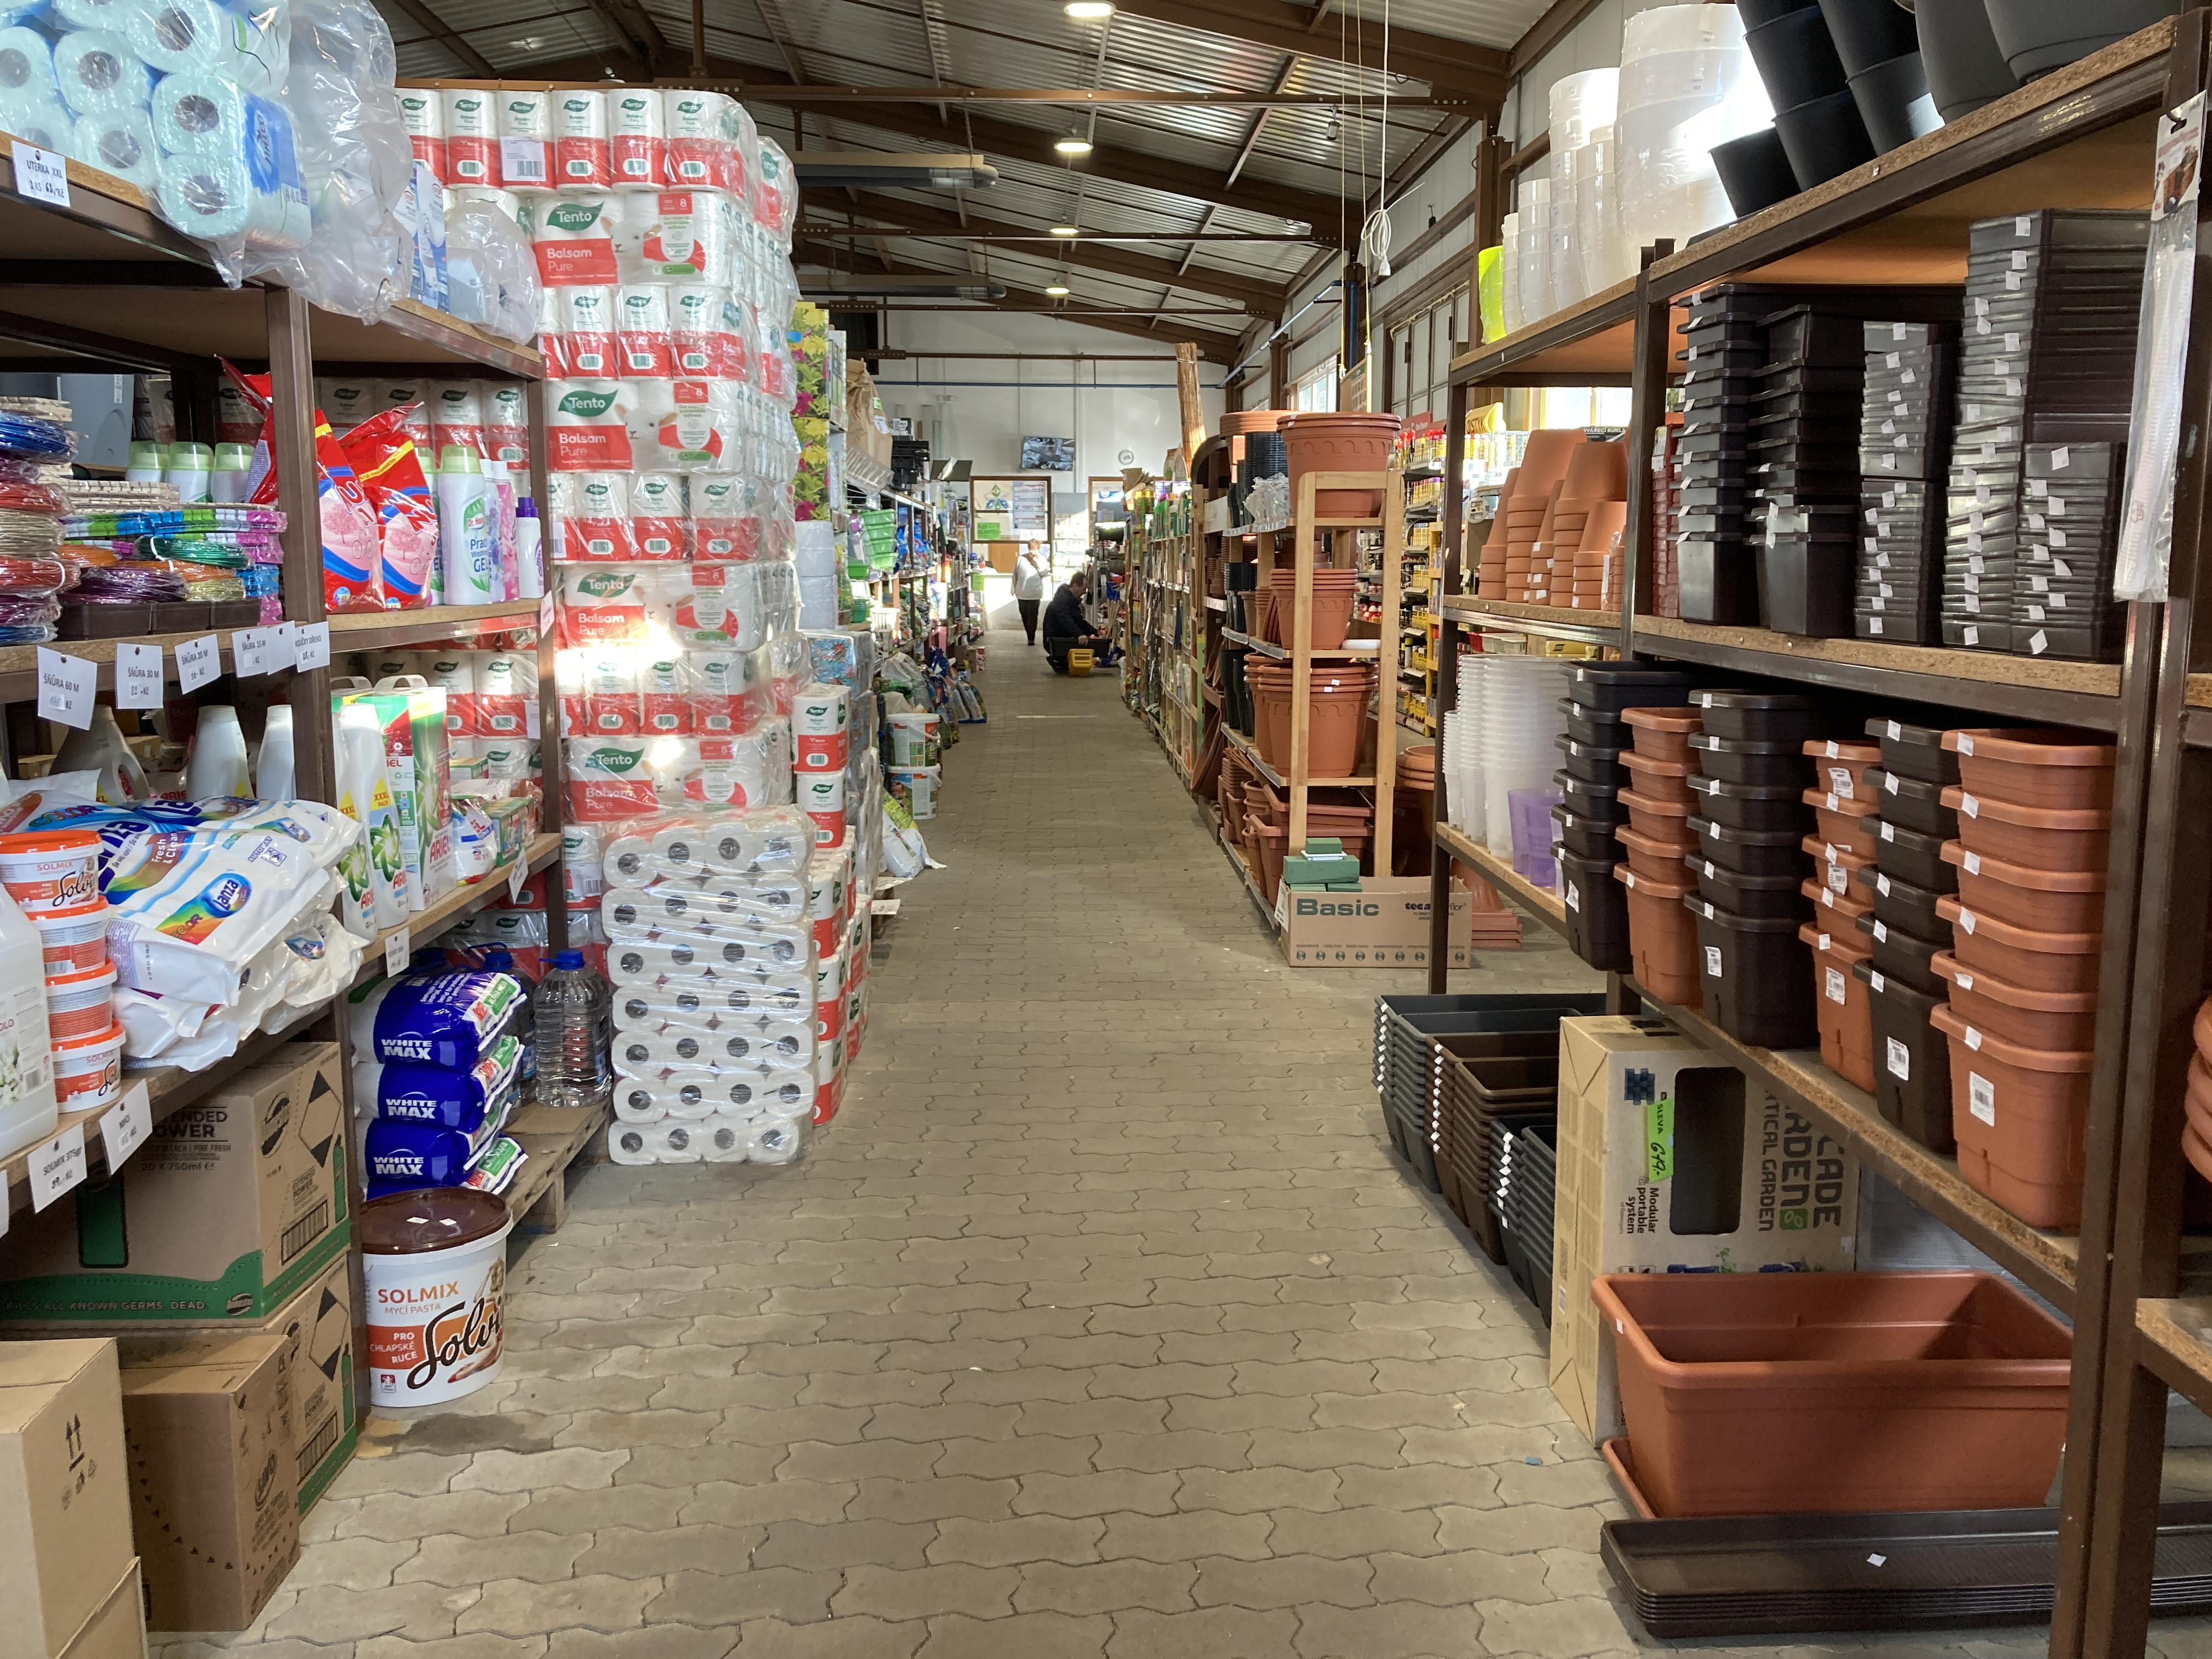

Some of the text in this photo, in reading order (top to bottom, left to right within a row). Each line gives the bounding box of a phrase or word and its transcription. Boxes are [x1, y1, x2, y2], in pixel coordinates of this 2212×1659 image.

[51, 167, 62, 179] XXL
[680, 199, 687, 207] 8
[557, 211, 592, 222] Tento
[547, 248, 592, 258] Balsam
[549, 262, 573, 272] Pure
[696, 388, 702, 396] 8
[568, 397, 606, 409] Tento
[559, 433, 606, 444] Balsam
[560, 446, 587, 457] Pure
[474, 556, 489, 572] GEL
[587, 579, 624, 590] Tento
[578, 613, 624, 624] Balsam
[580, 625, 604, 635] Pure
[197, 651, 203, 659] 20
[128, 667, 146, 678] ŠŇŮRA
[44, 673, 79, 693] ŠŇŮRA 60 M
[597, 754, 633, 765] Tento
[374, 792, 389, 801] XXXL
[586, 788, 635, 799] Balsam
[29, 805, 103, 828] COLOR
[152, 837, 166, 863] Fresh
[165, 832, 180, 858] Clean
[247, 836, 273, 863] AUTOMAT
[430, 834, 451, 864] ARIEL
[36, 861, 74, 872] SOLMIX
[213, 878, 239, 912] Lanza
[1296, 898, 1379, 916] Basic
[170, 914, 204, 939] COLOR
[382, 1039, 432, 1047] WHITE
[384, 1046, 432, 1060] MAX
[385, 1099, 437, 1107] WHITE
[388, 1106, 436, 1119] MAX
[168, 1162, 201, 1171] 750ml
[373, 1156, 424, 1165] WHITE
[376, 1164, 424, 1176] MAX
[1759, 1159, 1777, 1232] GARDEN
[1626, 1196, 1636, 1235] system
[1636, 1187, 1646, 1234] portable
[1647, 1187, 1660, 1234] Modular
[377, 1280, 460, 1304] SOLMIX
[70, 1301, 119, 1311] KNOWN
[122, 1301, 166, 1311] GERMS.
[171, 1301, 208, 1311] DEAD.
[385, 1302, 442, 1315] MYCÍ PASTA
[393, 1332, 415, 1341] PRO
[369, 1340, 415, 1353] CHLAPSKÉ
[391, 1350, 419, 1364] RUCE
